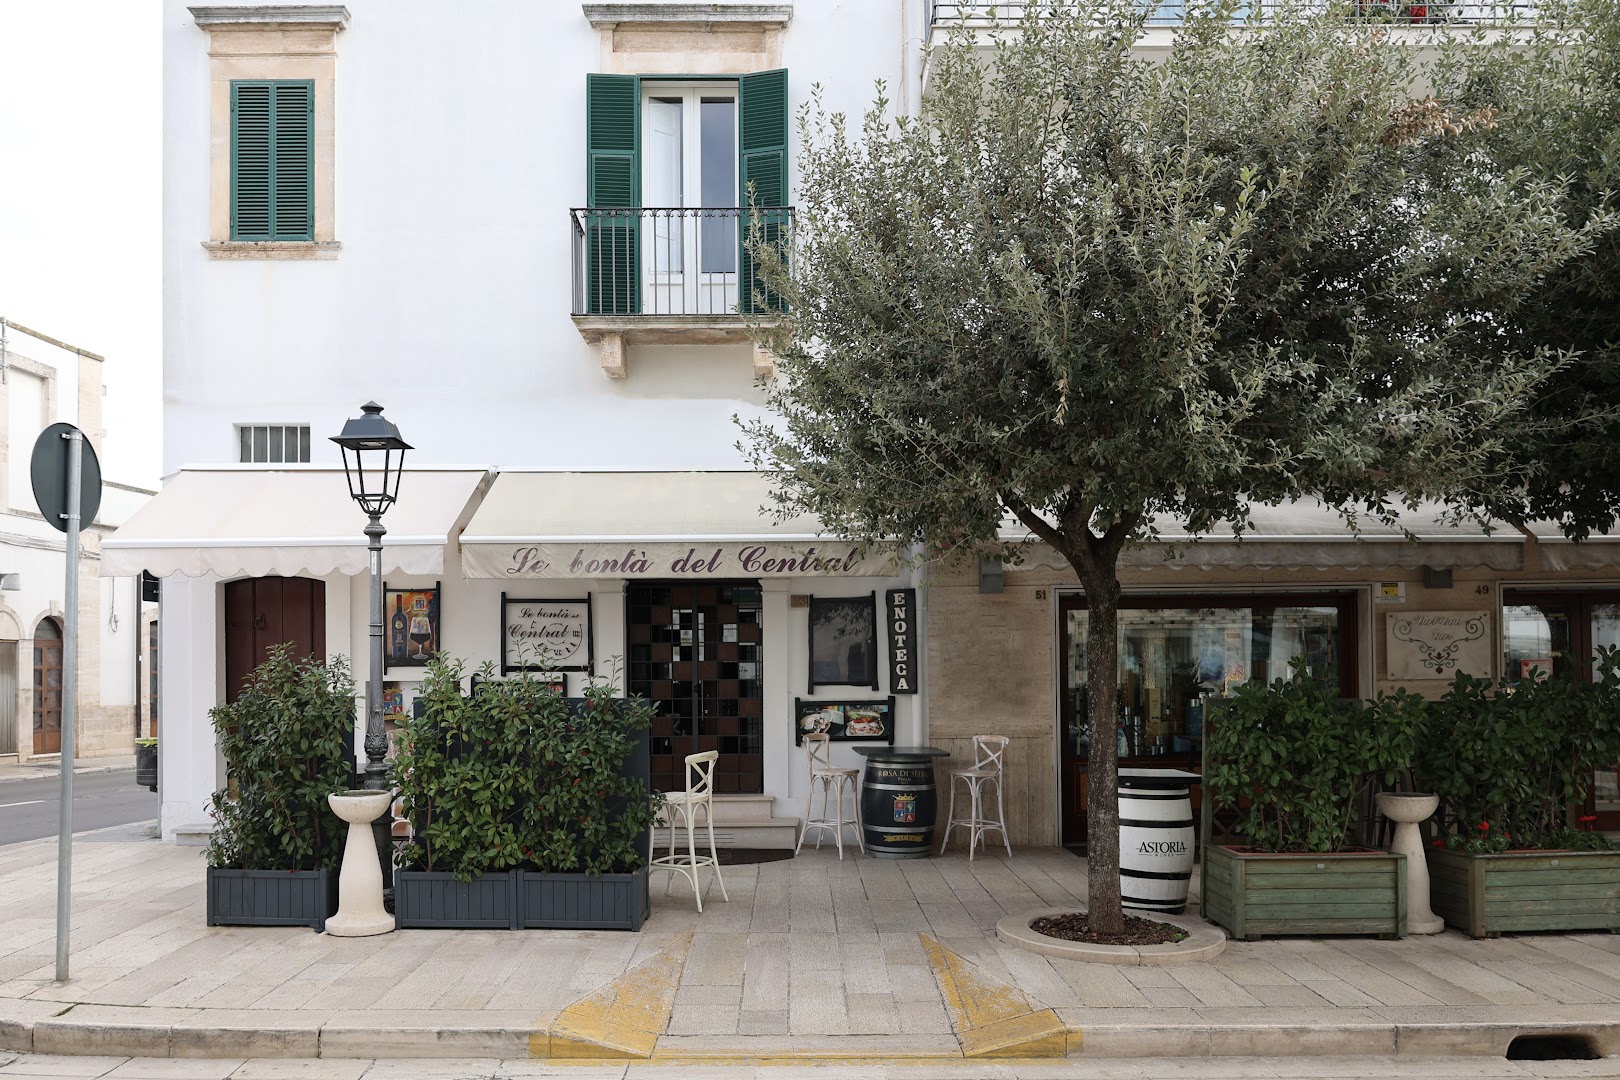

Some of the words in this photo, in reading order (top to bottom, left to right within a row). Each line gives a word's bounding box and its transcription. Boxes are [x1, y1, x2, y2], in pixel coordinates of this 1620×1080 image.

[507, 547, 549, 574] Le
[569, 548, 654, 574] bontà
[671, 548, 723, 573] del
[738, 546, 858, 572] Central
[1035, 590, 1046, 600] 51
[1474, 585, 1489, 595] 49
[519, 607, 535, 618] Le
[537, 607, 571, 618] bontà
[508, 624, 569, 638] Central
[893, 592, 909, 690] ENOTECA
[878, 769, 897, 777] ROSA
[899, 769, 909, 777] DI
[1139, 841, 1186, 853] ASTORIA
